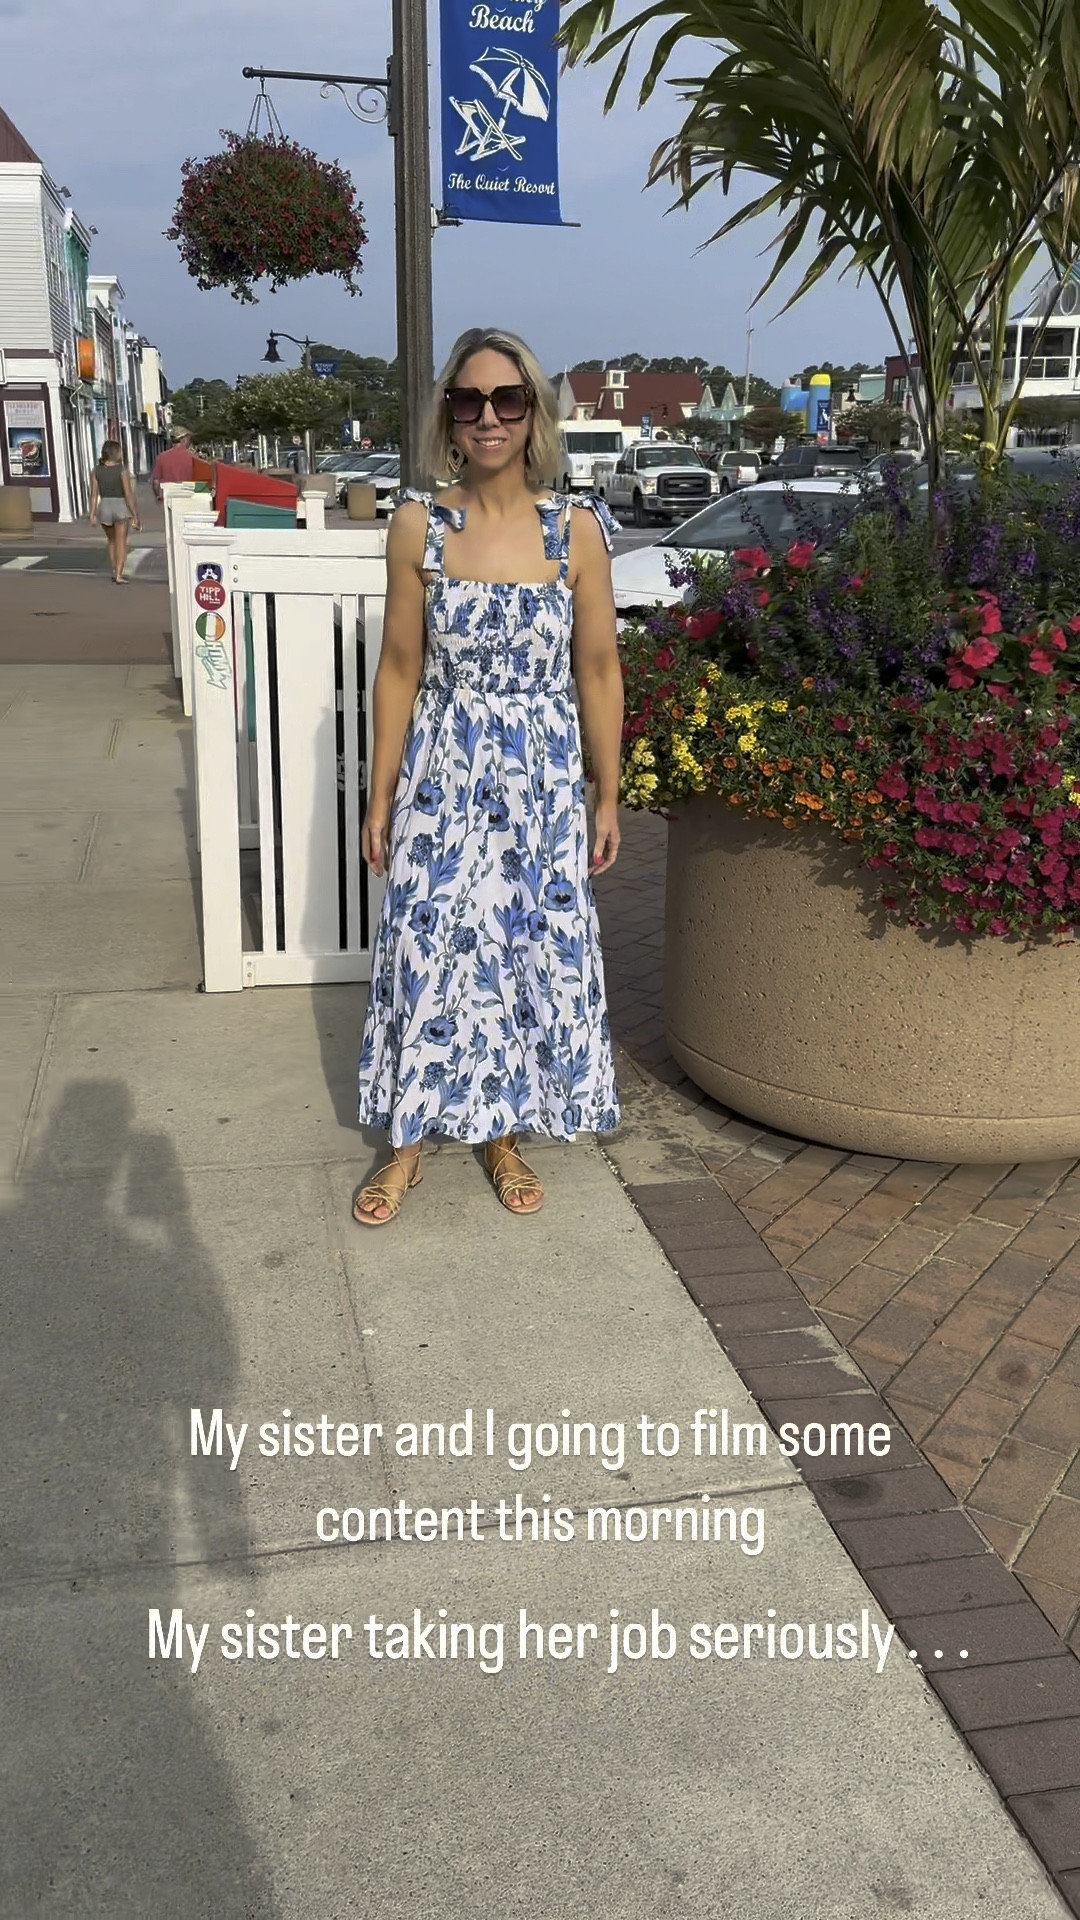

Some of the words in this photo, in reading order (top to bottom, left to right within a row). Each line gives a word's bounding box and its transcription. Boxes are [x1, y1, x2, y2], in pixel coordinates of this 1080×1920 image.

[468, 4, 536, 34] Beach
[447, 173, 472, 190] The
[475, 174, 510, 192] Quiet
[513, 176, 556, 195] Resort
[199, 586, 221, 595] TIPP
[199, 592, 221, 601] HILL
